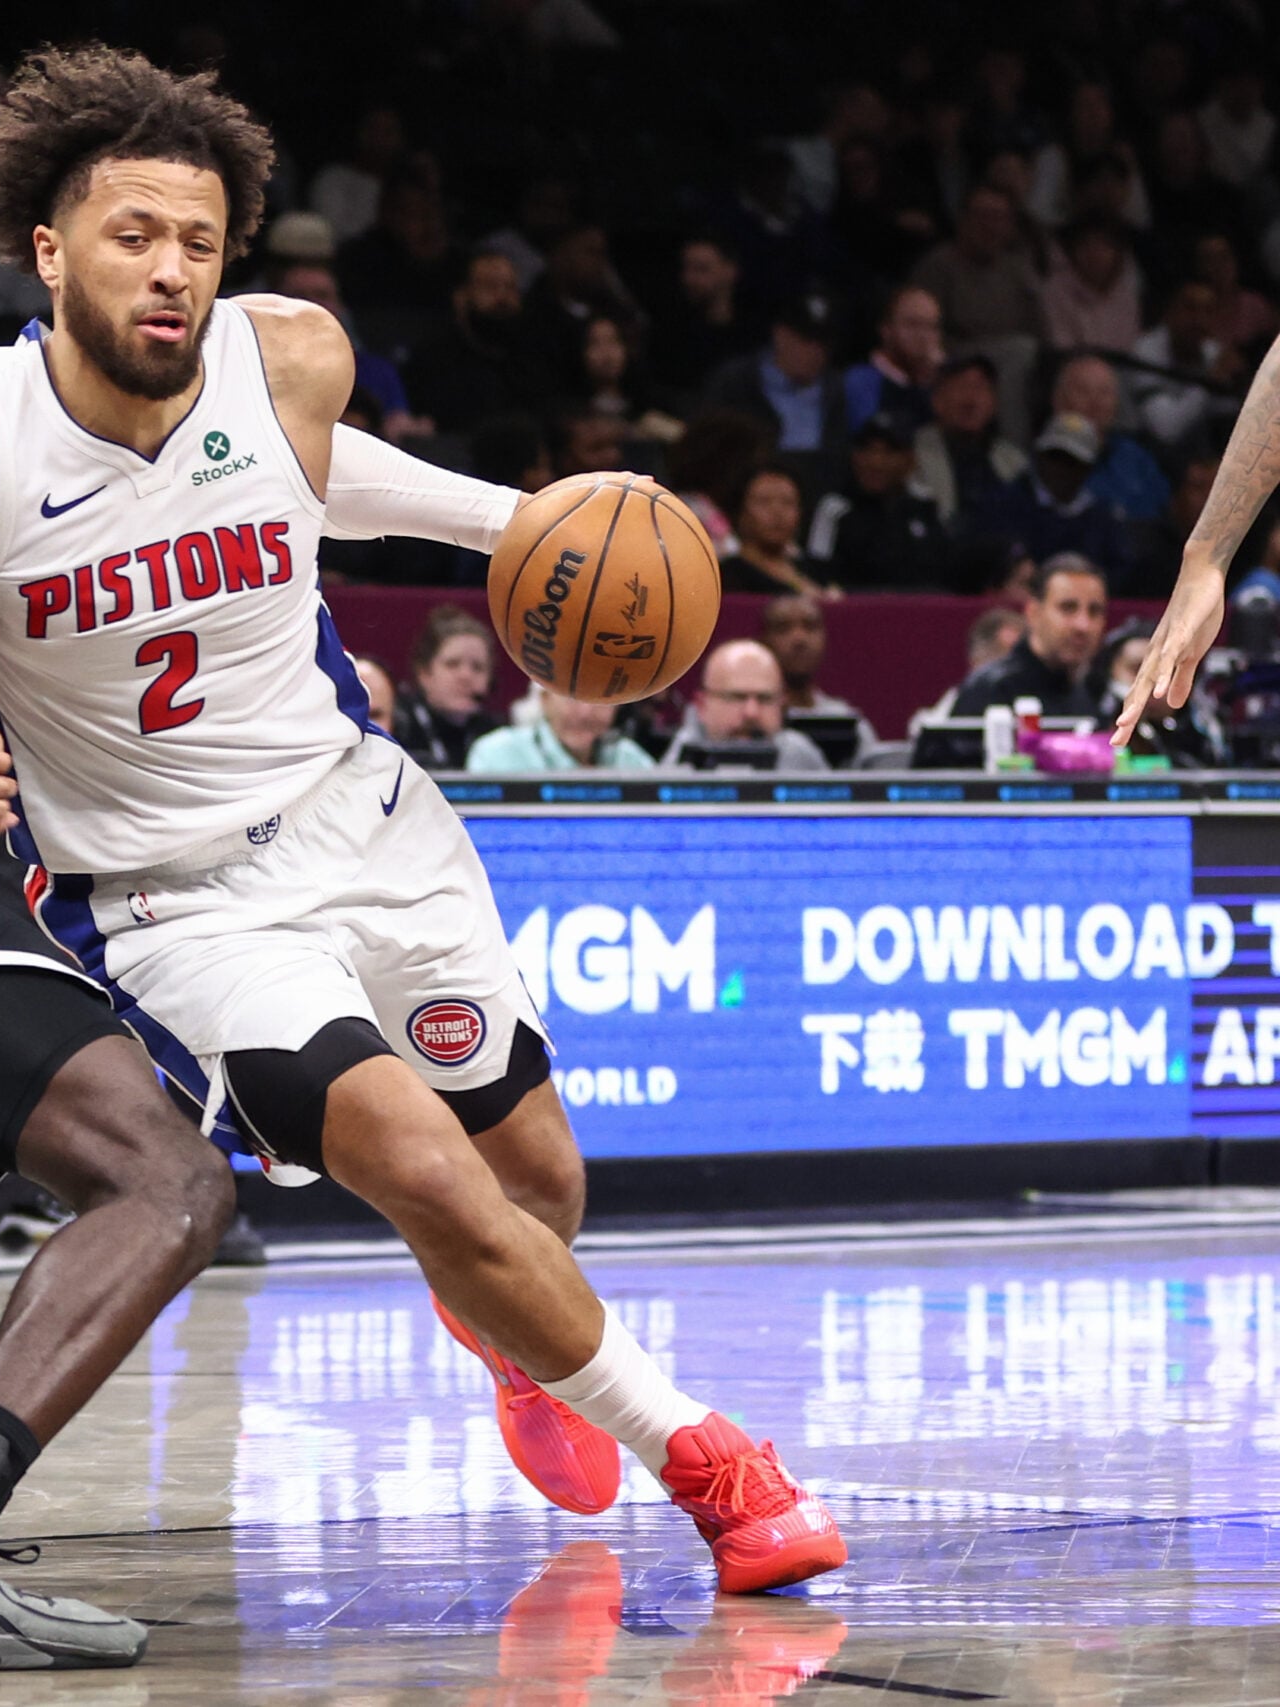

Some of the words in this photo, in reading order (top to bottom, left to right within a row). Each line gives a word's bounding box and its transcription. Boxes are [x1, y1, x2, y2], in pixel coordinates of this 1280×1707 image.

[191, 453, 258, 486] StockX
[19, 522, 293, 639] PISTONS
[522, 547, 588, 683] Wilson
[135, 630, 206, 735] 2
[801, 903, 1235, 985] DOWNLOAD
[422, 1018, 471, 1033] DETROIT
[423, 1030, 473, 1044] PISTONS
